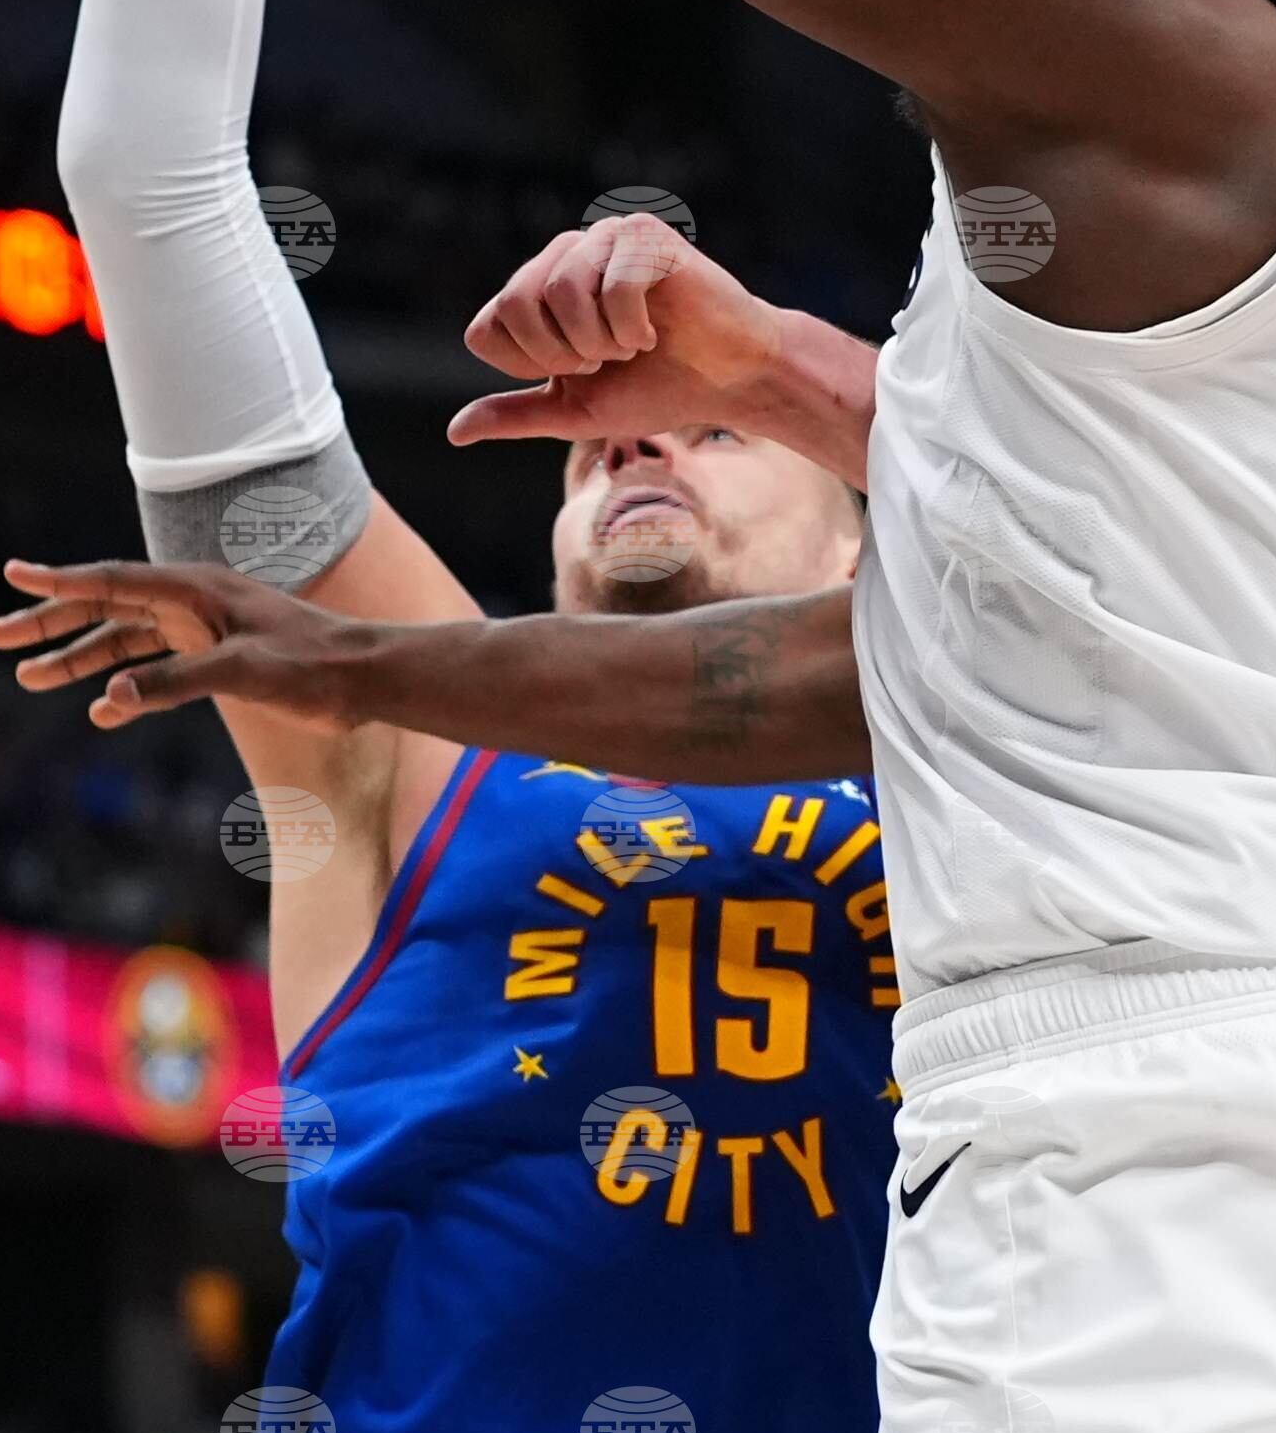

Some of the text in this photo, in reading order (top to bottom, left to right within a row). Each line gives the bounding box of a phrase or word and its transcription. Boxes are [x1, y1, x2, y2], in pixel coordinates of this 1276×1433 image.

[504, 815, 709, 1001] MILE
[647, 896, 815, 1081] 15
[596, 1108, 835, 1234] CITY
